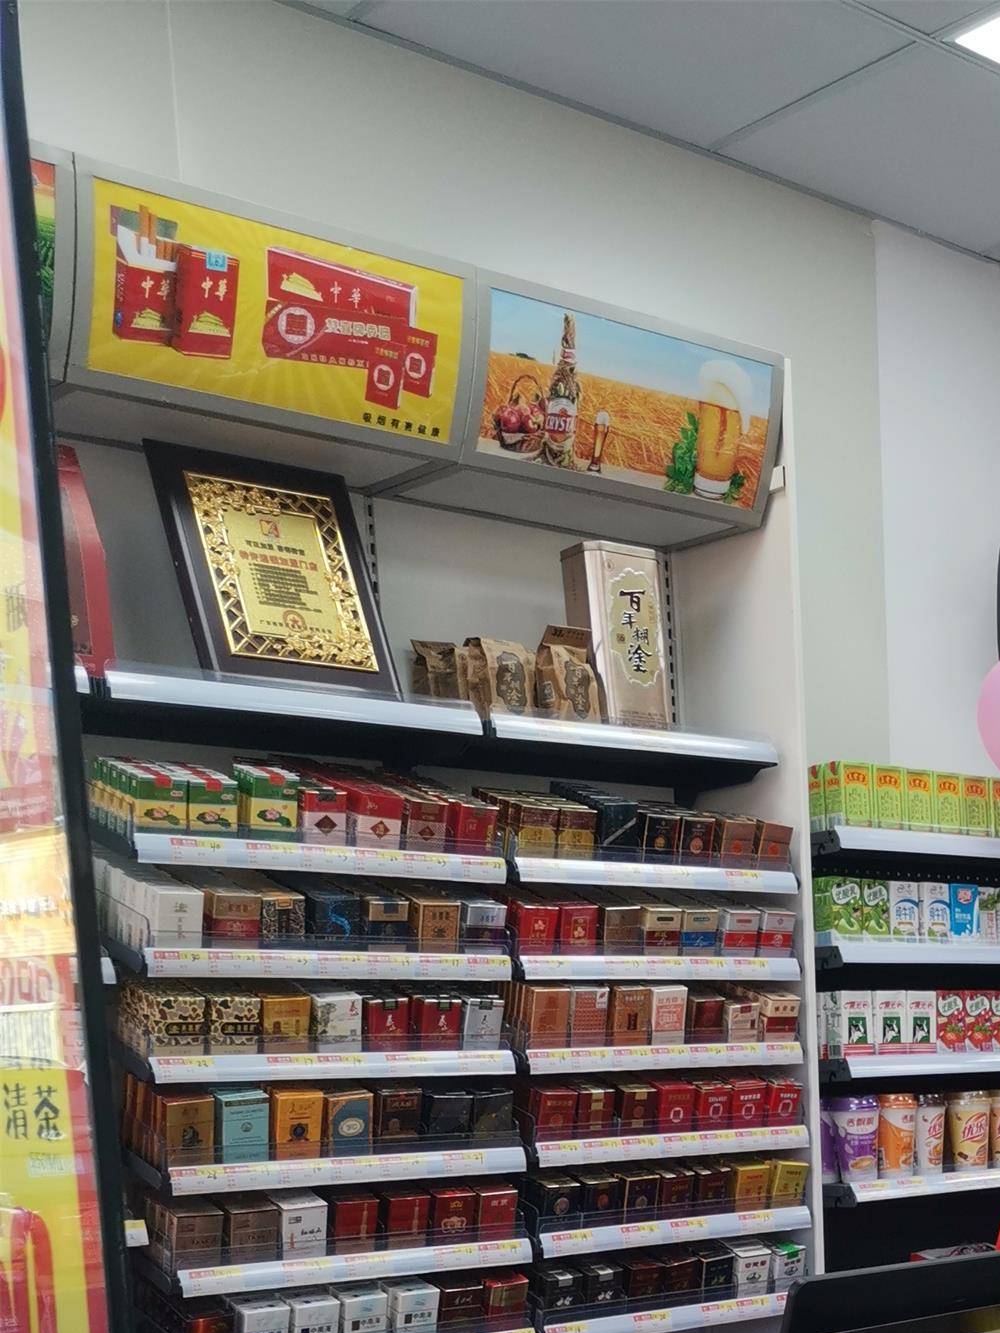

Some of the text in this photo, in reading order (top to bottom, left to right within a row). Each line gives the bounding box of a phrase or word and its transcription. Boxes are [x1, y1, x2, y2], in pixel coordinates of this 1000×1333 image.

[362, 411, 441, 438] 吸烟有害健康
